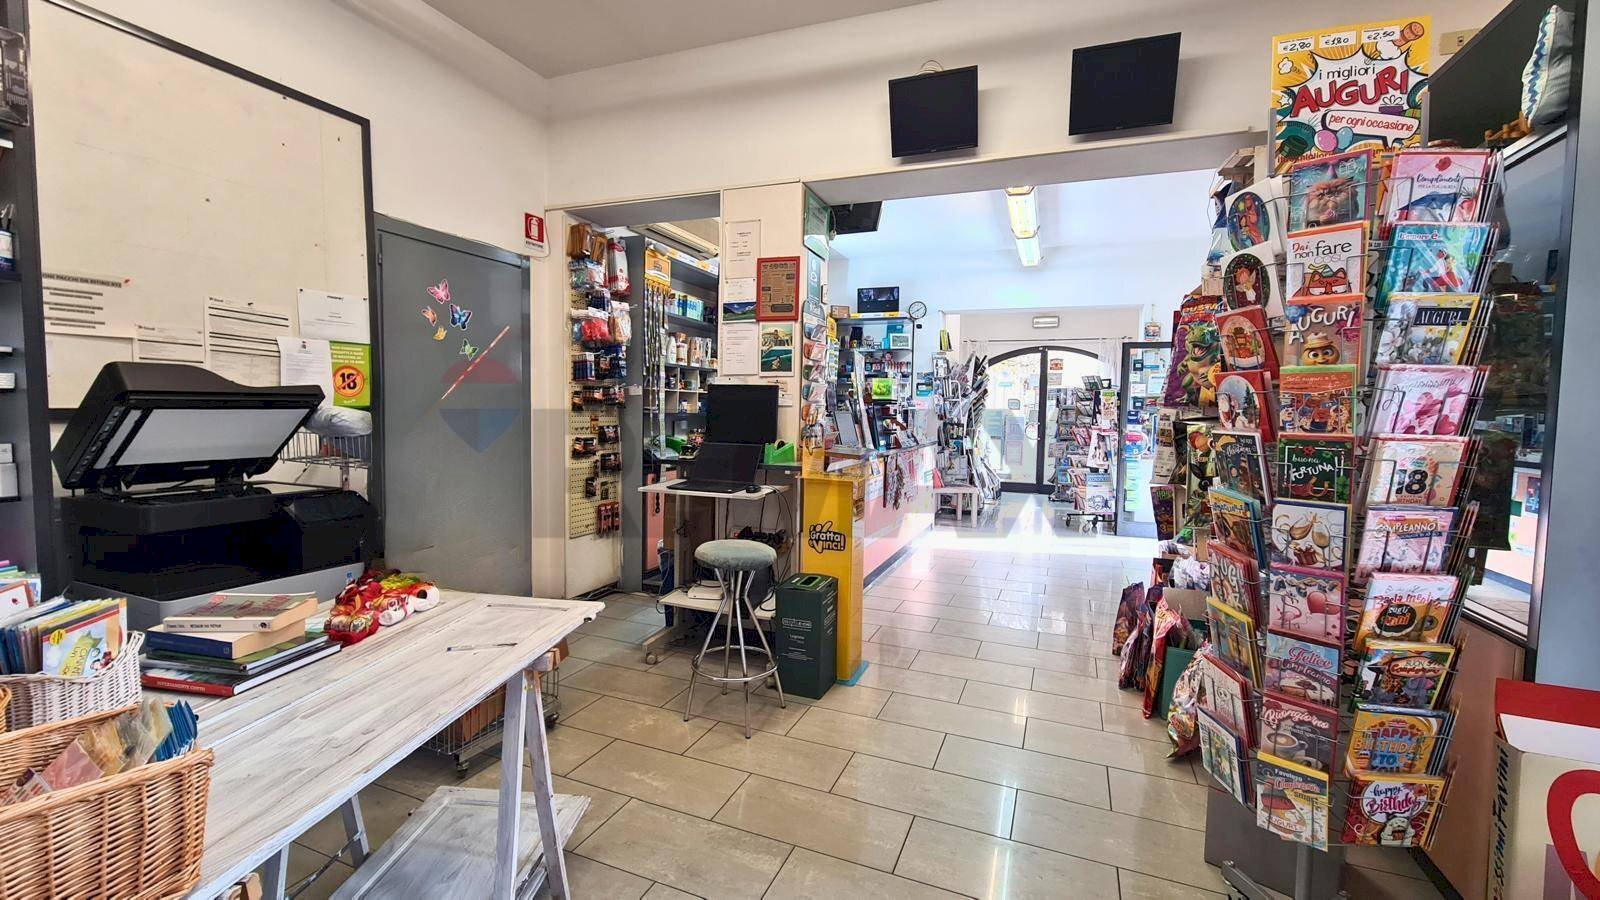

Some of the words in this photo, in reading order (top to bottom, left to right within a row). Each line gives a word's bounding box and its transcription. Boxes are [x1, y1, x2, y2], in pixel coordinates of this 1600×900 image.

[1326, 64, 1376, 81] migliori
[1290, 66, 1409, 118] AUGURI
[1328, 114, 1345, 126] per
[1346, 115, 1365, 128] ogni
[1365, 118, 1414, 131] occasione
[1294, 250, 1314, 259] non
[1315, 240, 1352, 256] fare
[1289, 305, 1356, 345] AUGURI
[1416, 308, 1463, 325] AUGURI
[1292, 455, 1321, 464] buona
[1396, 468, 1428, 495] 18
[810, 531, 841, 542] Gratta
[813, 534, 845, 554] Vinci!
[1288, 646, 1333, 669] Felice
[1263, 706, 1329, 731] Buongiorno
[1375, 728, 1420, 742] HAPPY
[1370, 784, 1402, 801] happy
[1366, 796, 1424, 815] Birthday
